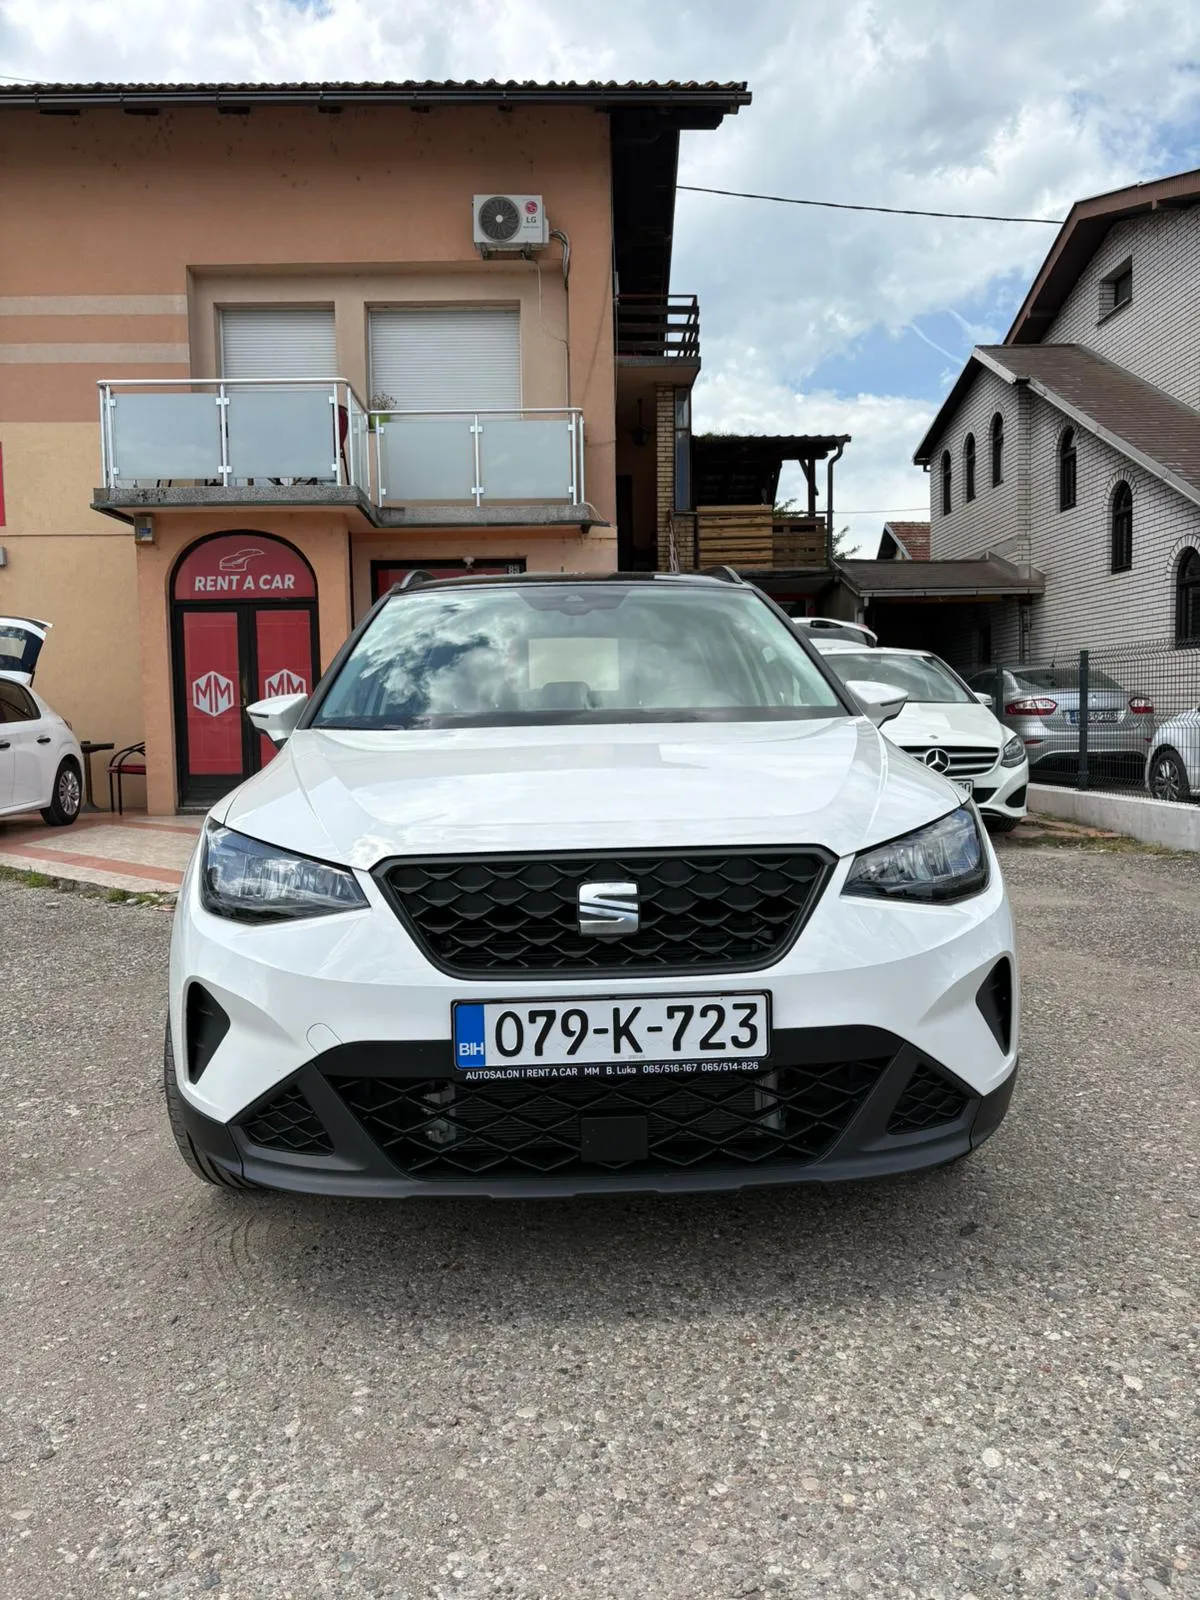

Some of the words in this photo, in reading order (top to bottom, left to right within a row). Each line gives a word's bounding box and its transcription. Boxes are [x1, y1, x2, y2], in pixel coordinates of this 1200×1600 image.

[526, 216, 537, 224] LG
[194, 575, 240, 592] RENT
[243, 575, 255, 591] A
[259, 574, 295, 590] CAR
[459, 1042, 484, 1056] BIH
[495, 1003, 758, 1057] 079-K-723
[465, 1070, 519, 1080] AUTOSALON
[527, 1069, 550, 1077] RENT
[551, 1068, 558, 1077] A
[559, 1068, 578, 1076] CAR
[584, 1067, 600, 1075] MM
[606, 1066, 615, 1075] B.
[617, 1066, 637, 1074] Luka
[642, 1063, 698, 1074] 065/516-167
[701, 1062, 759, 1072] 065/514-826
